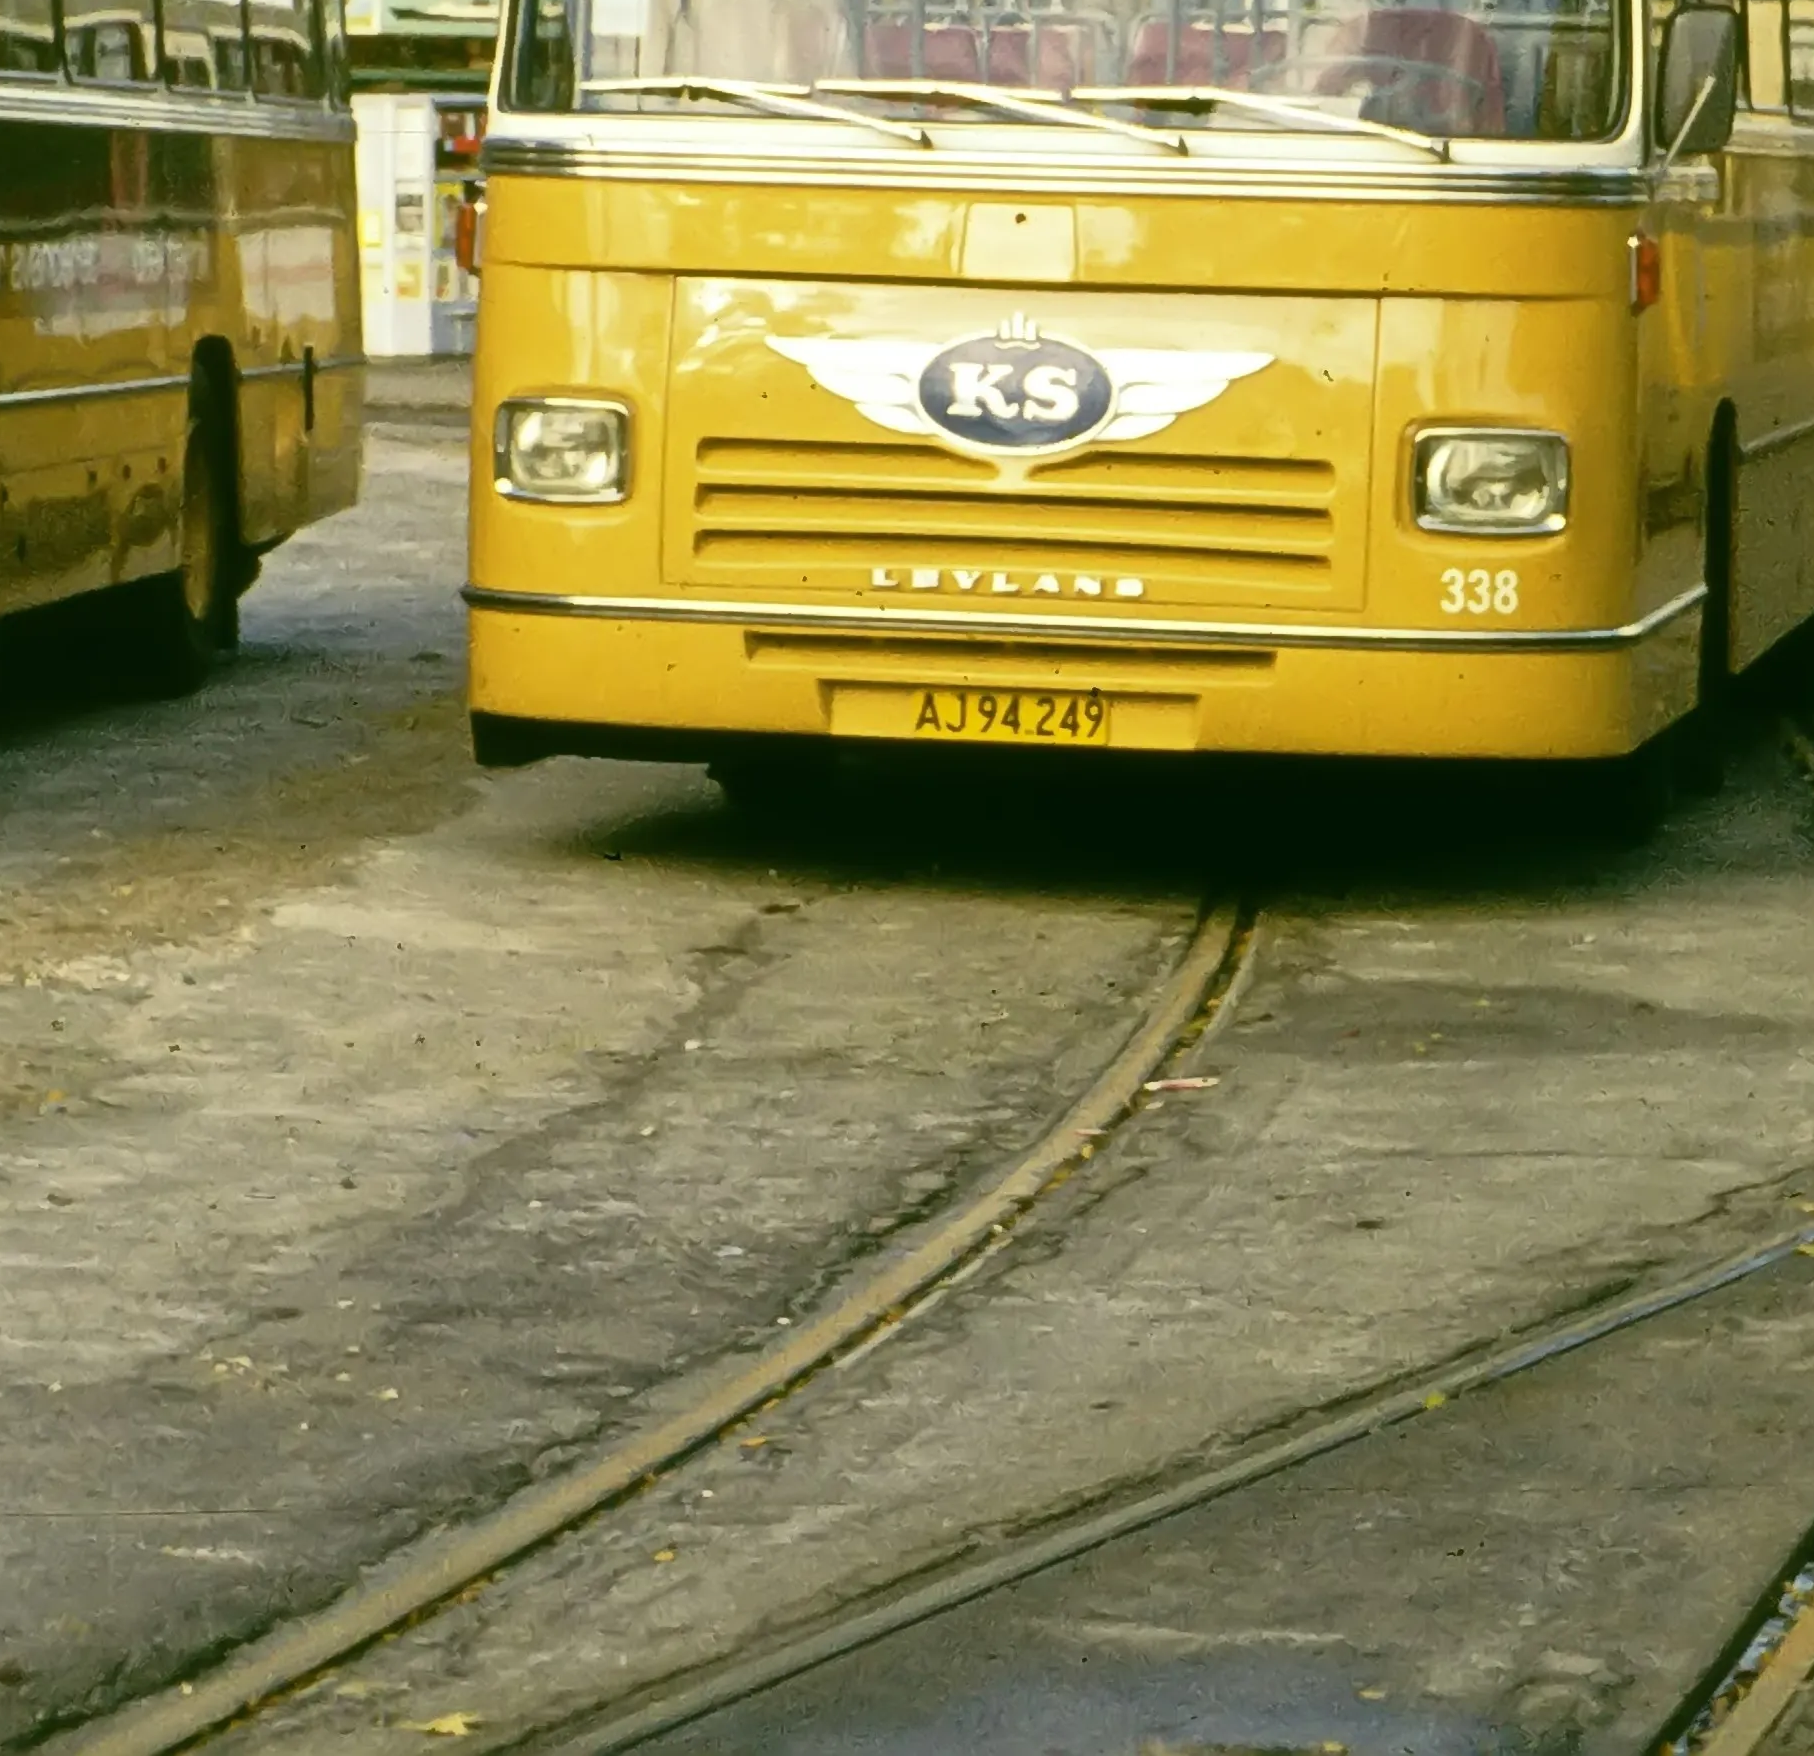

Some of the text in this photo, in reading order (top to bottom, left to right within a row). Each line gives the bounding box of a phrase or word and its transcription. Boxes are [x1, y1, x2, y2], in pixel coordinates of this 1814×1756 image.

[946, 361, 1078, 421] KS
[871, 566, 1144, 597] LEYLAND
[1440, 568, 1519, 614] 338
